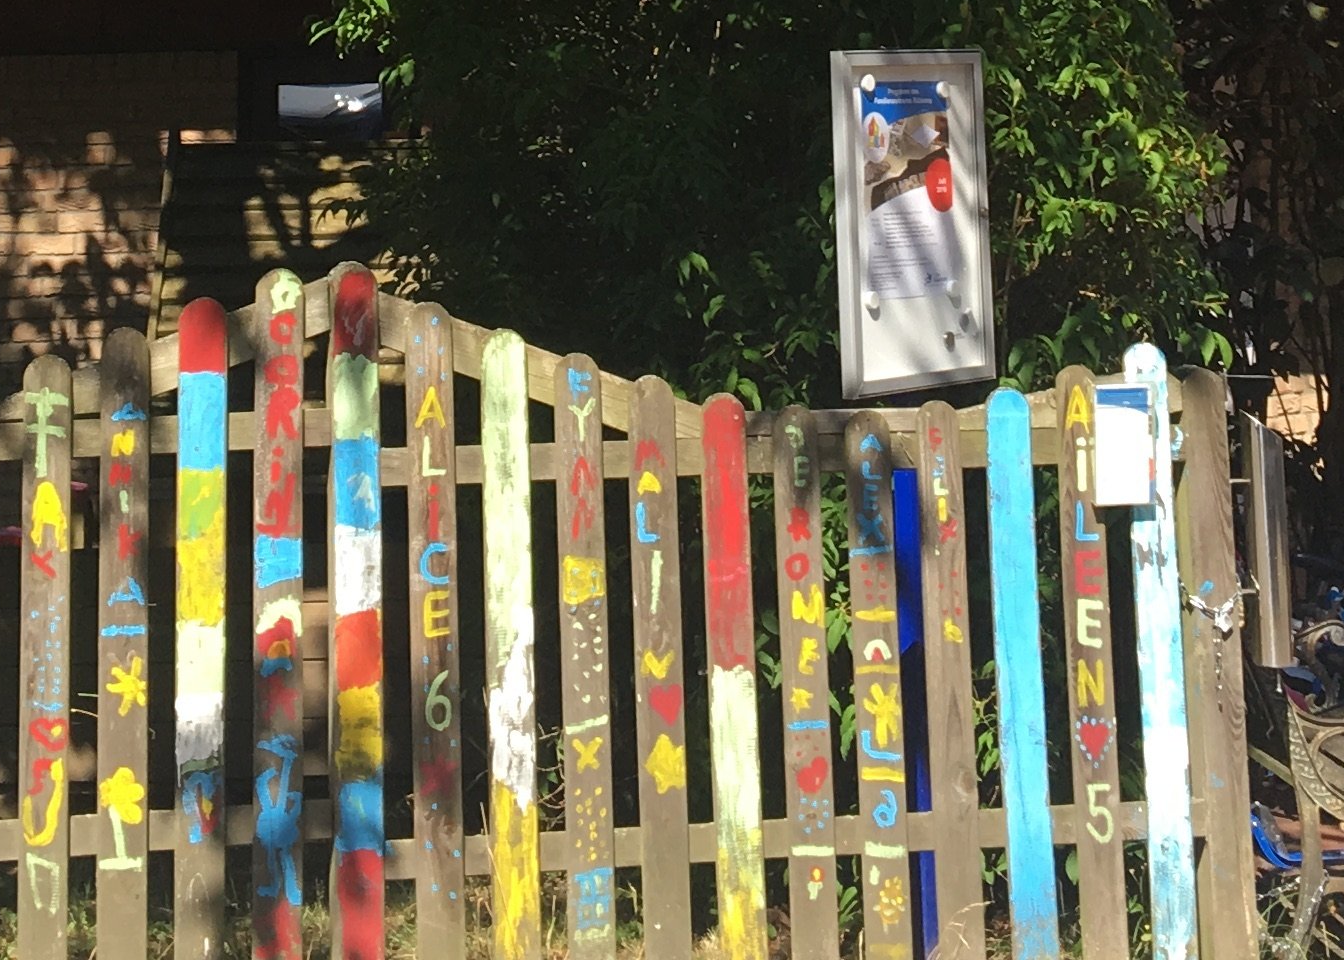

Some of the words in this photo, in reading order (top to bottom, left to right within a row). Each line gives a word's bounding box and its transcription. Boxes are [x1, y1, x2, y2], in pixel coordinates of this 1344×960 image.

[633, 440, 674, 679] MALIN
[425, 670, 452, 731] 6
[1086, 783, 1114, 844] 5
